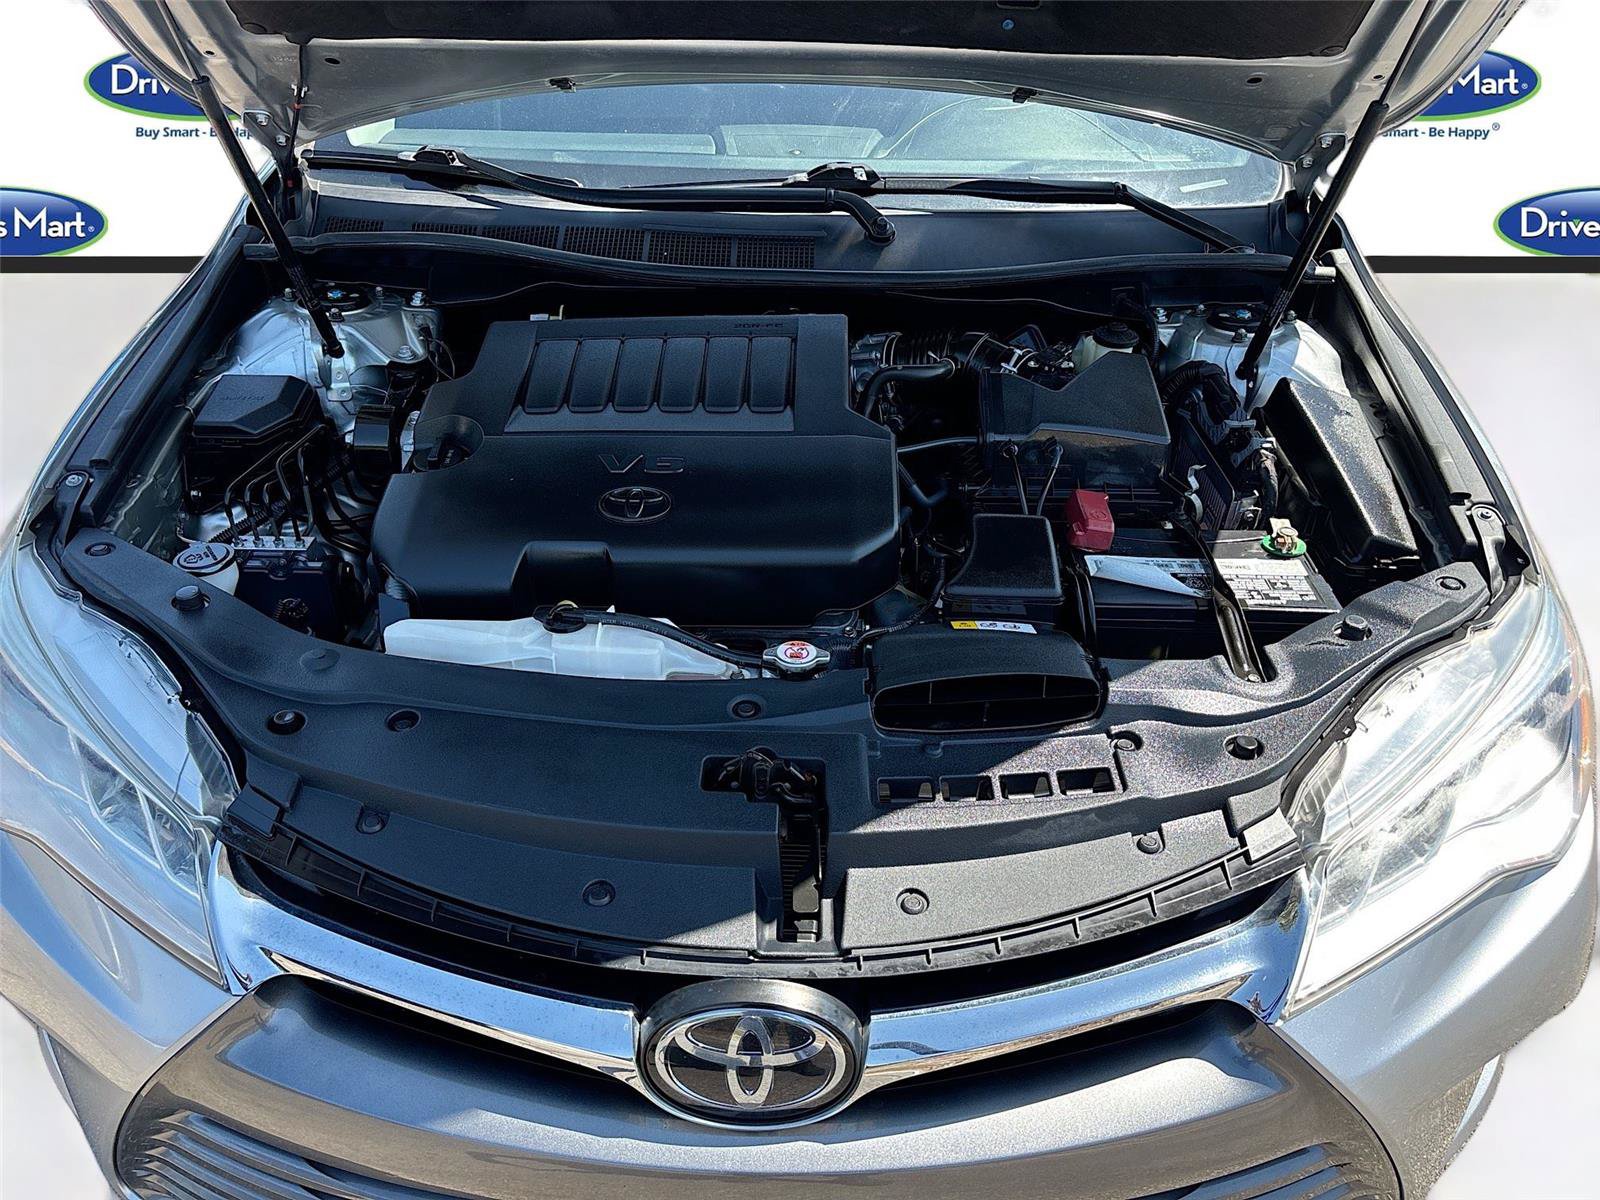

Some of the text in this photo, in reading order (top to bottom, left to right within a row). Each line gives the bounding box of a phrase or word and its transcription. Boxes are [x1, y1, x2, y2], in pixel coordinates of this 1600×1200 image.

[136, 127, 159, 140] Buy
[163, 127, 199, 137] Smart
[1429, 127, 1444, 137] Be
[1448, 127, 1490, 140] Happy
[598, 454, 685, 474] V6
